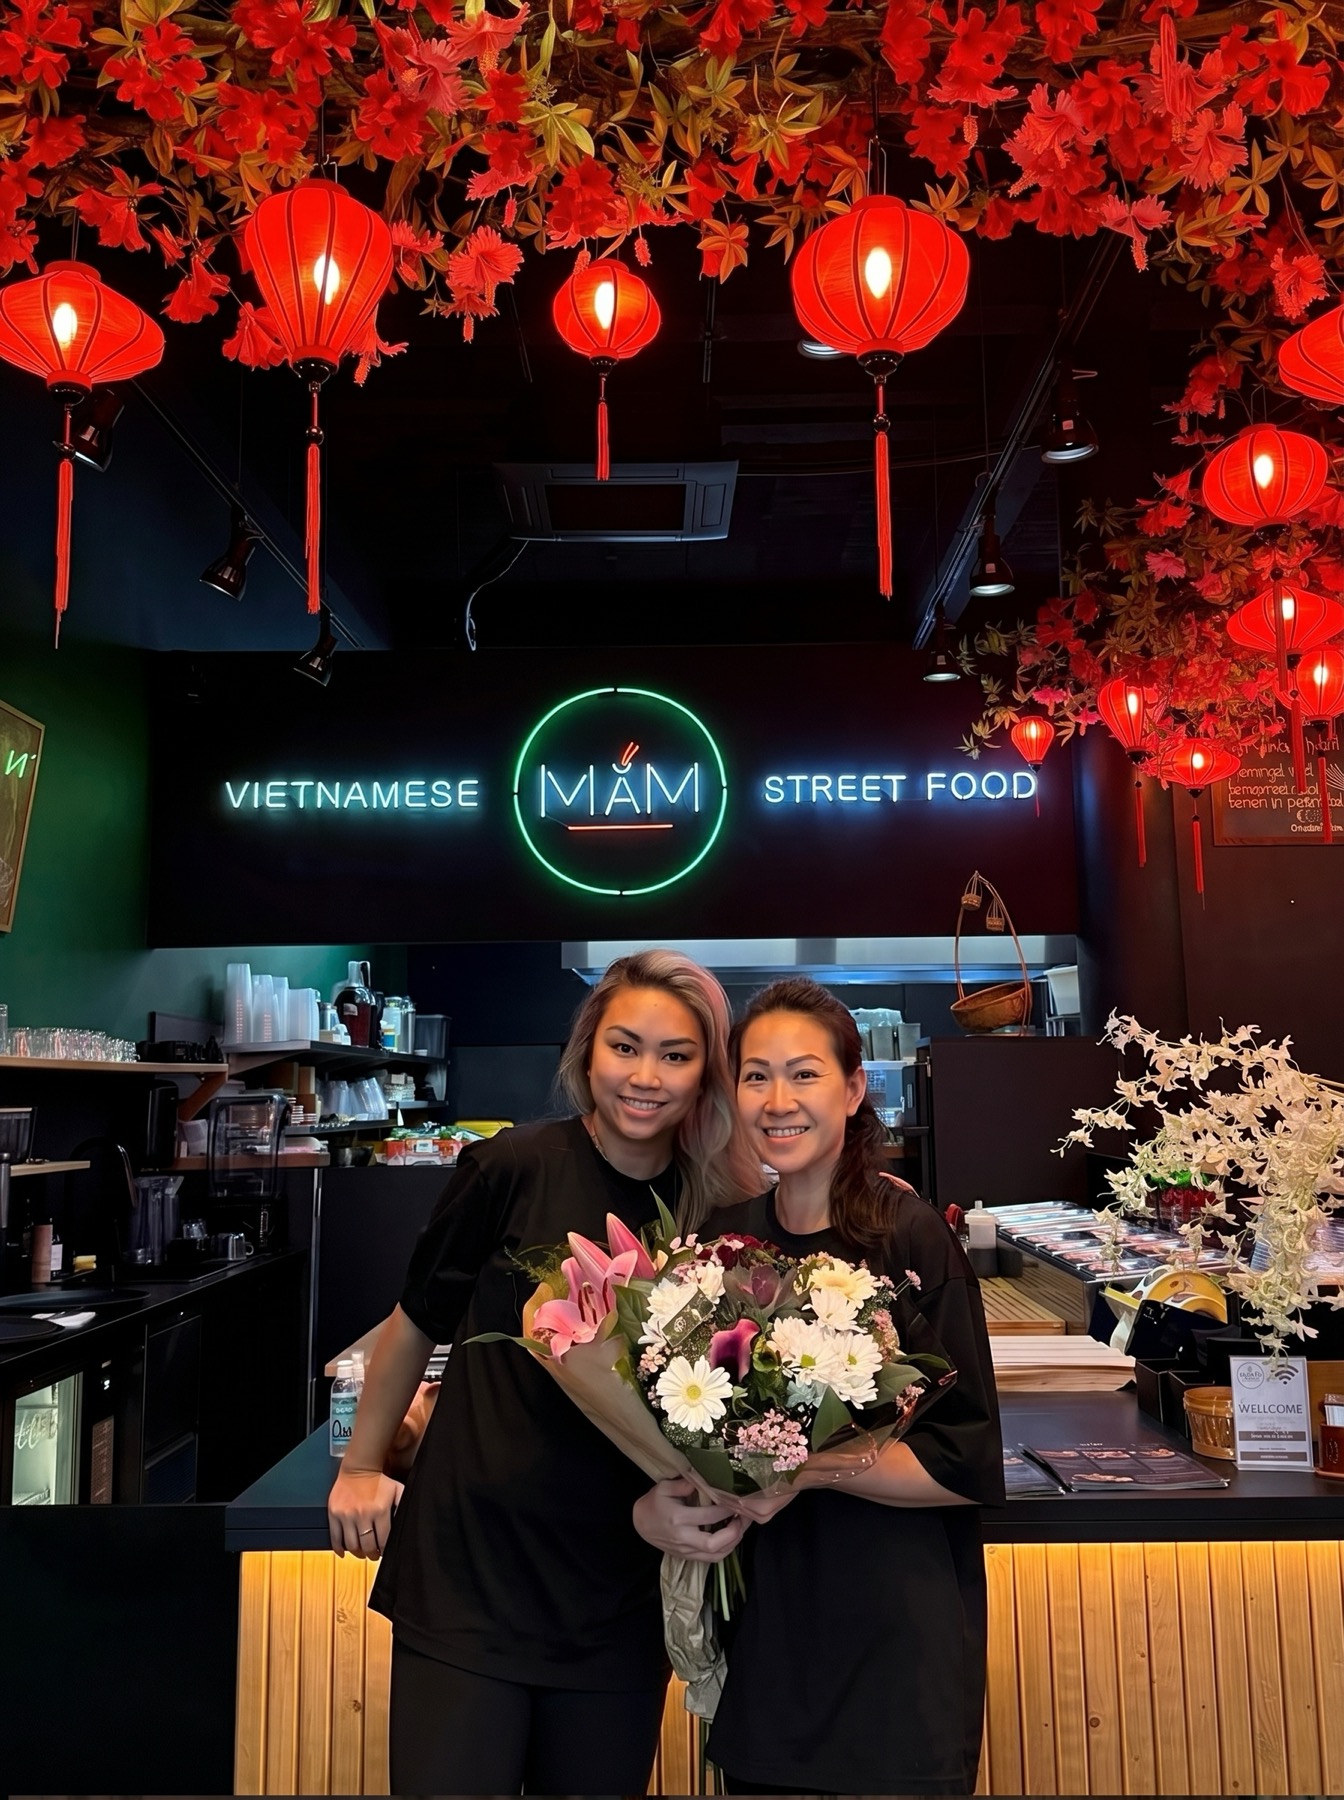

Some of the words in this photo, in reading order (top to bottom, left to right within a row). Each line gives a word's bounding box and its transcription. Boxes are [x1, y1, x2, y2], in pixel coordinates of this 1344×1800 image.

[224, 779, 479, 809] VIETNAMESE
[764, 774, 907, 803] STREET
[926, 771, 1037, 801] FOOD
[1238, 1403, 1303, 1415] WELLCOME
